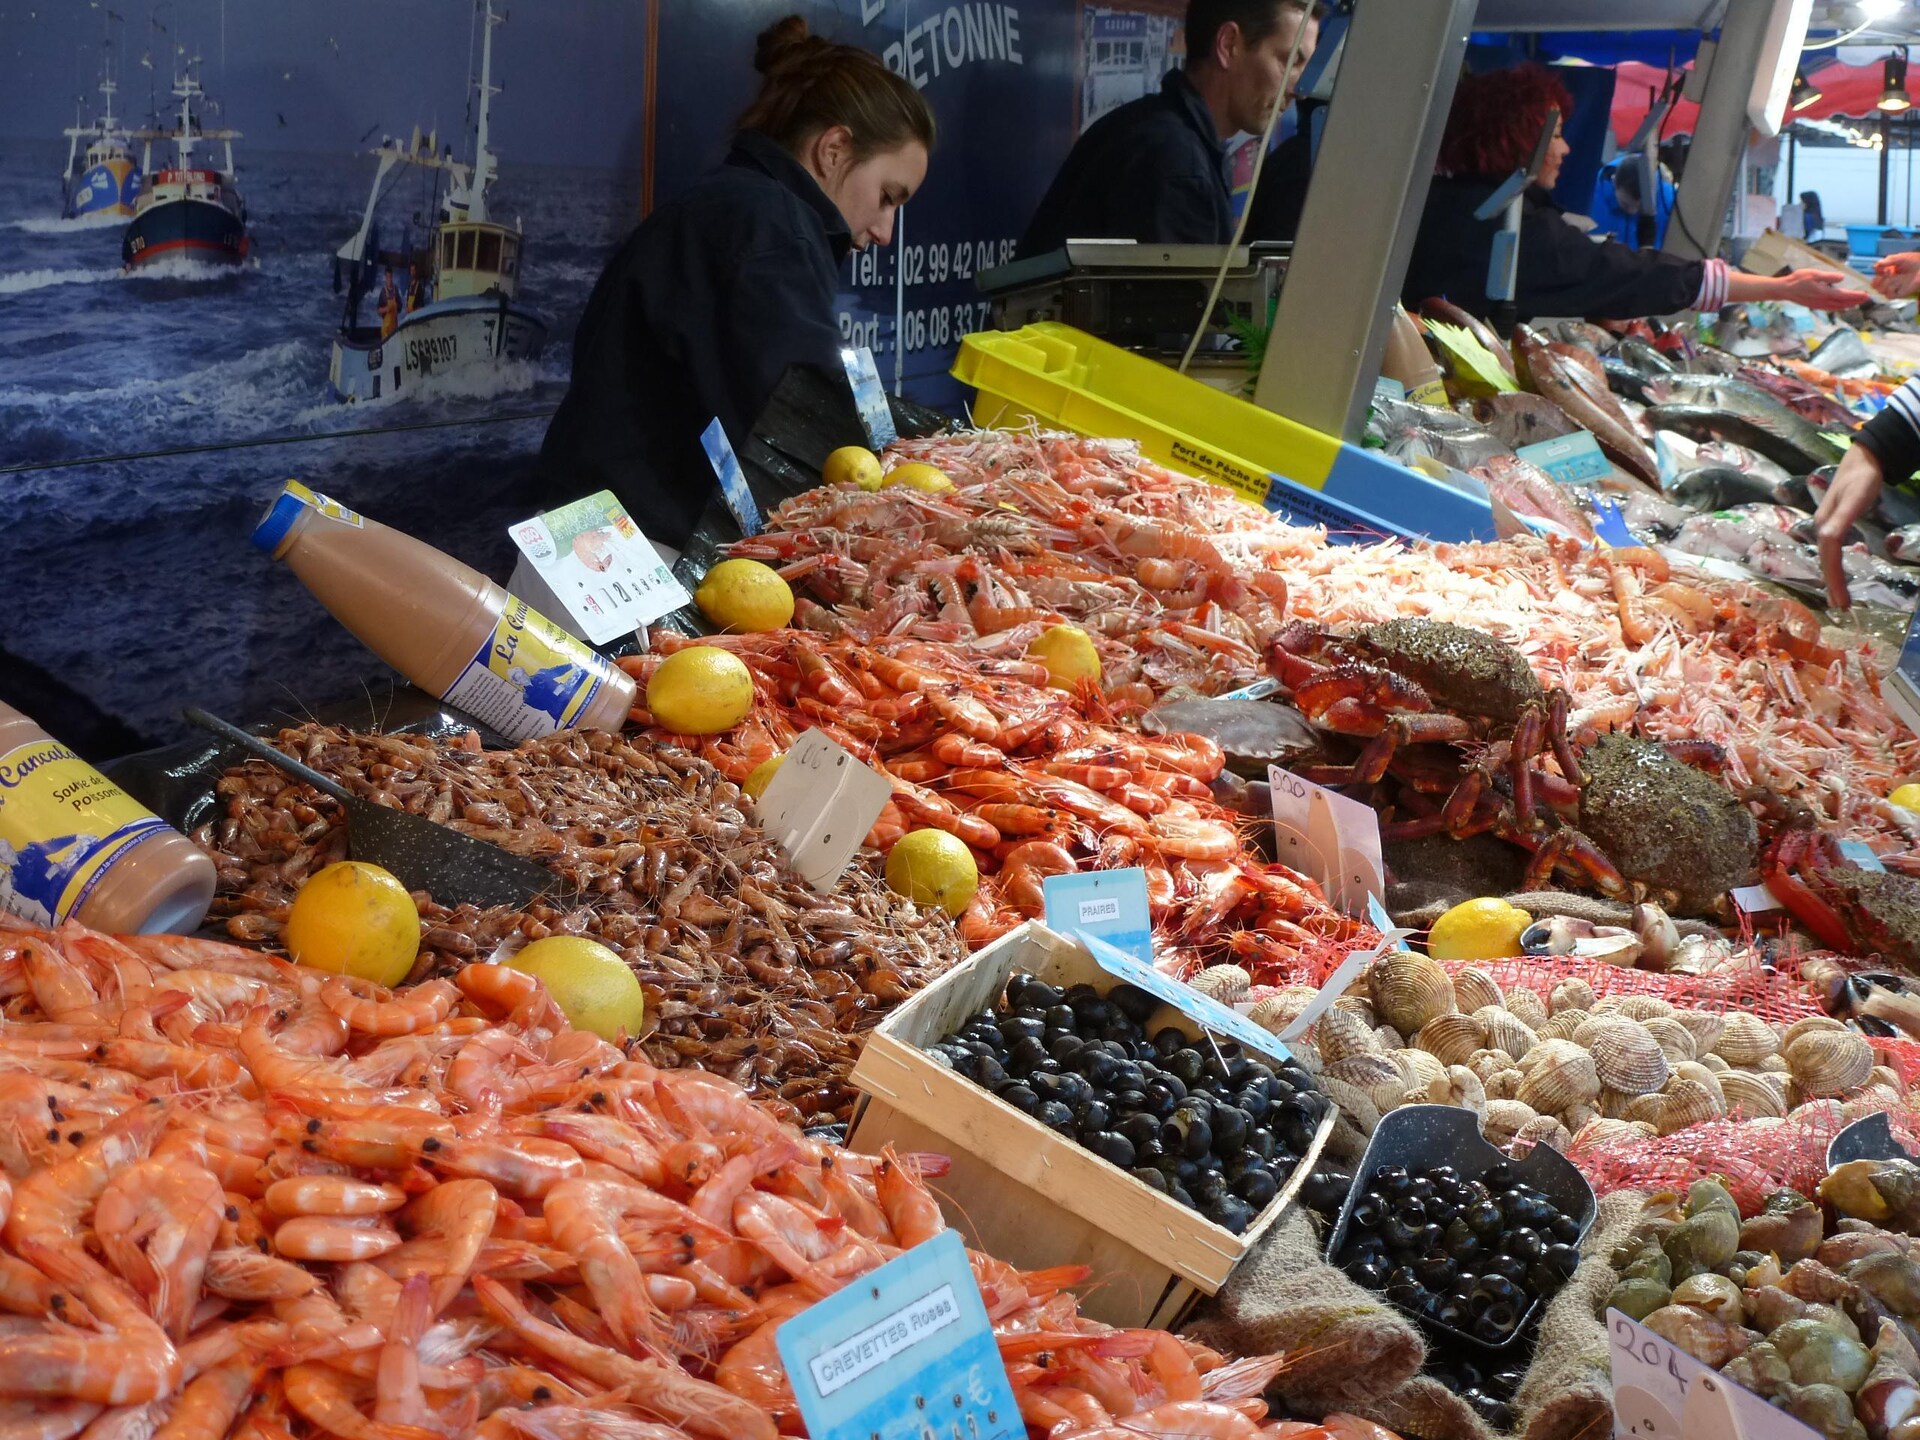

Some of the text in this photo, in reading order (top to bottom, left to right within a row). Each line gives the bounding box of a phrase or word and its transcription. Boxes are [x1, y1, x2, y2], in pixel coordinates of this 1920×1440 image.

[852, 243, 882, 287] Tél.
[904, 245, 924, 286] 02
[929, 243, 949, 284] 99
[953, 242, 972, 280] 42
[976, 241, 995, 272] 04
[839, 312, 883, 353] Port.
[905, 310, 925, 351] 06
[930, 307, 949, 346] 08
[954, 303, 973, 342] 33
[1172, 441, 1197, 460] Port
[1199, 454, 1212, 465] de
[1216, 460, 1250, 483] Pêche
[1253, 477, 1267, 489] de
[1270, 482, 1311, 509] Lorient
[495, 634, 519, 665] La
[0, 745, 83, 788] Cancala
[1081, 902, 1116, 917] PRAIRES
[821, 1300, 952, 1382] CREVETTES Roses
